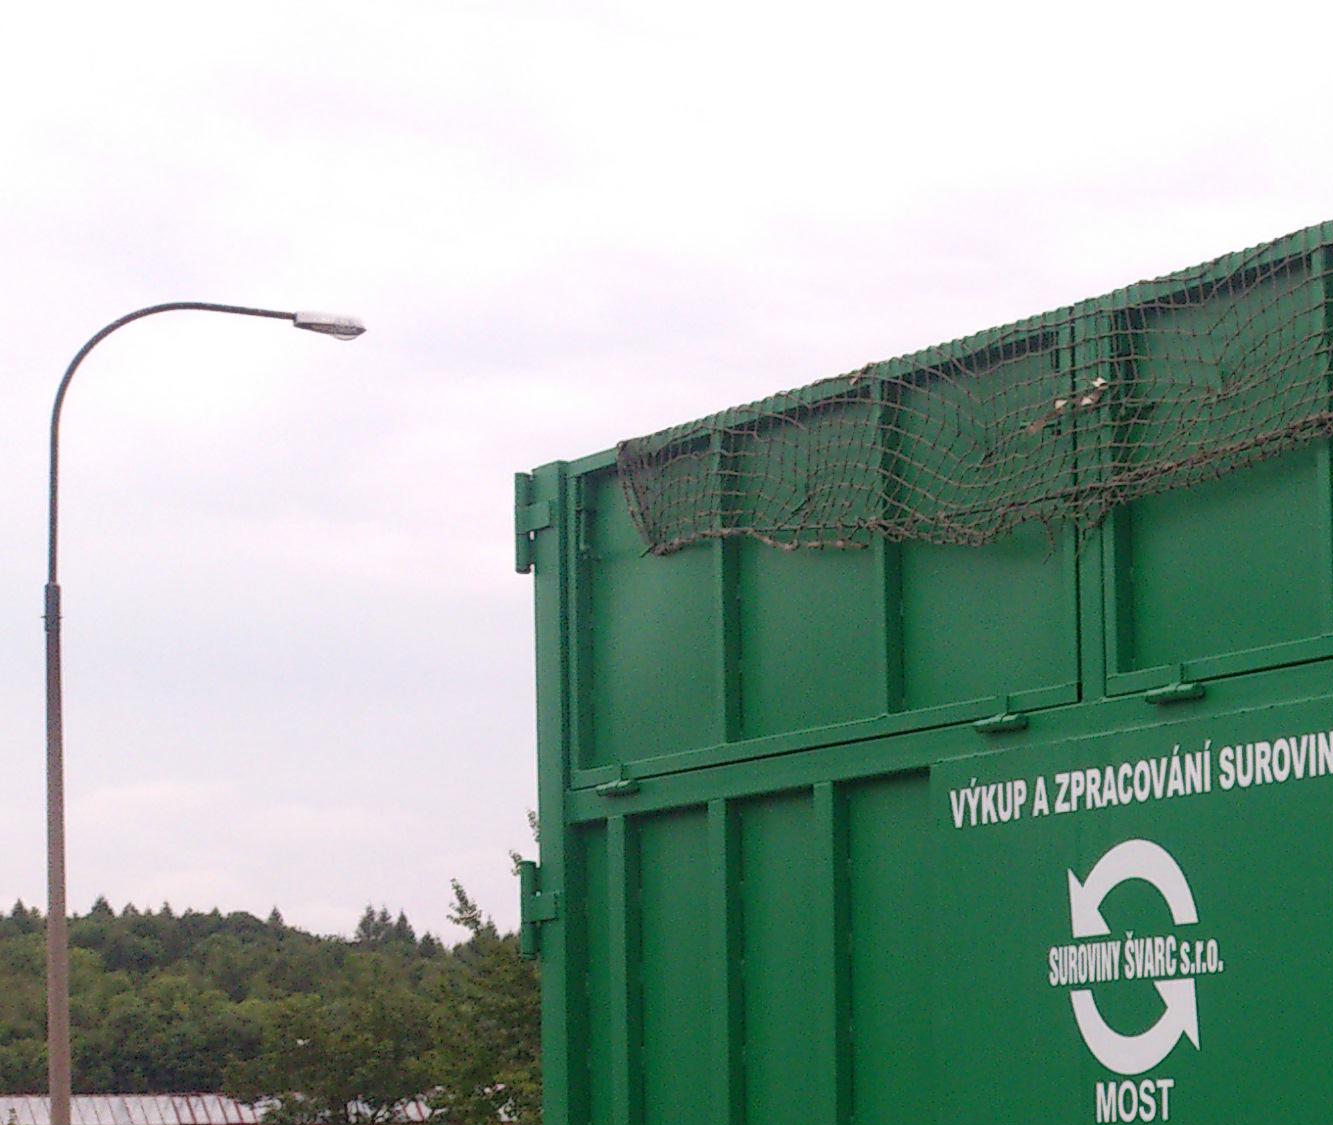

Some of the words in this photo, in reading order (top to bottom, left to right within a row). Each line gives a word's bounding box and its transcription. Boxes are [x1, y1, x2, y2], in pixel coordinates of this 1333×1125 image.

[951, 778, 1027, 828] VÝKUP
[1033, 777, 1050, 817] A
[1055, 740, 1212, 813] ZPRACOVÁNÍ
[1049, 939, 1121, 986] SUROVINY
[1124, 931, 1177, 979] ŠVARC
[1180, 938, 1224, 974] s.r.o.
[1096, 1078, 1174, 1123] MOST
